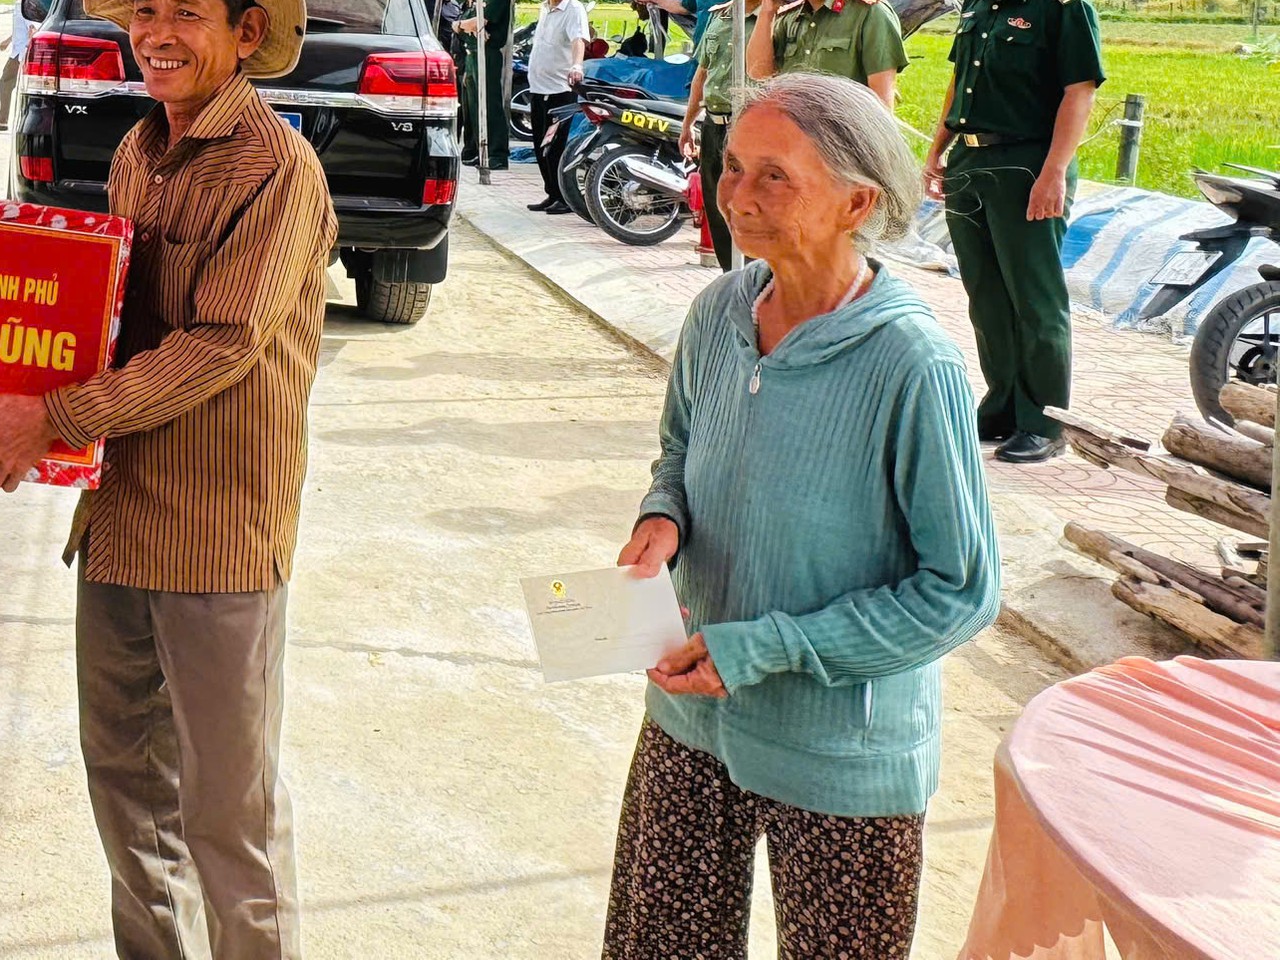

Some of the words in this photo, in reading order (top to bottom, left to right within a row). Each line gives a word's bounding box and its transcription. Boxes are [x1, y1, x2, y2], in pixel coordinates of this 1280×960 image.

[64, 104, 88, 114] VX
[391, 122, 413, 132] V8
[621, 110, 669, 132] DQTV
[23, 272, 59, 306] PHỦ
